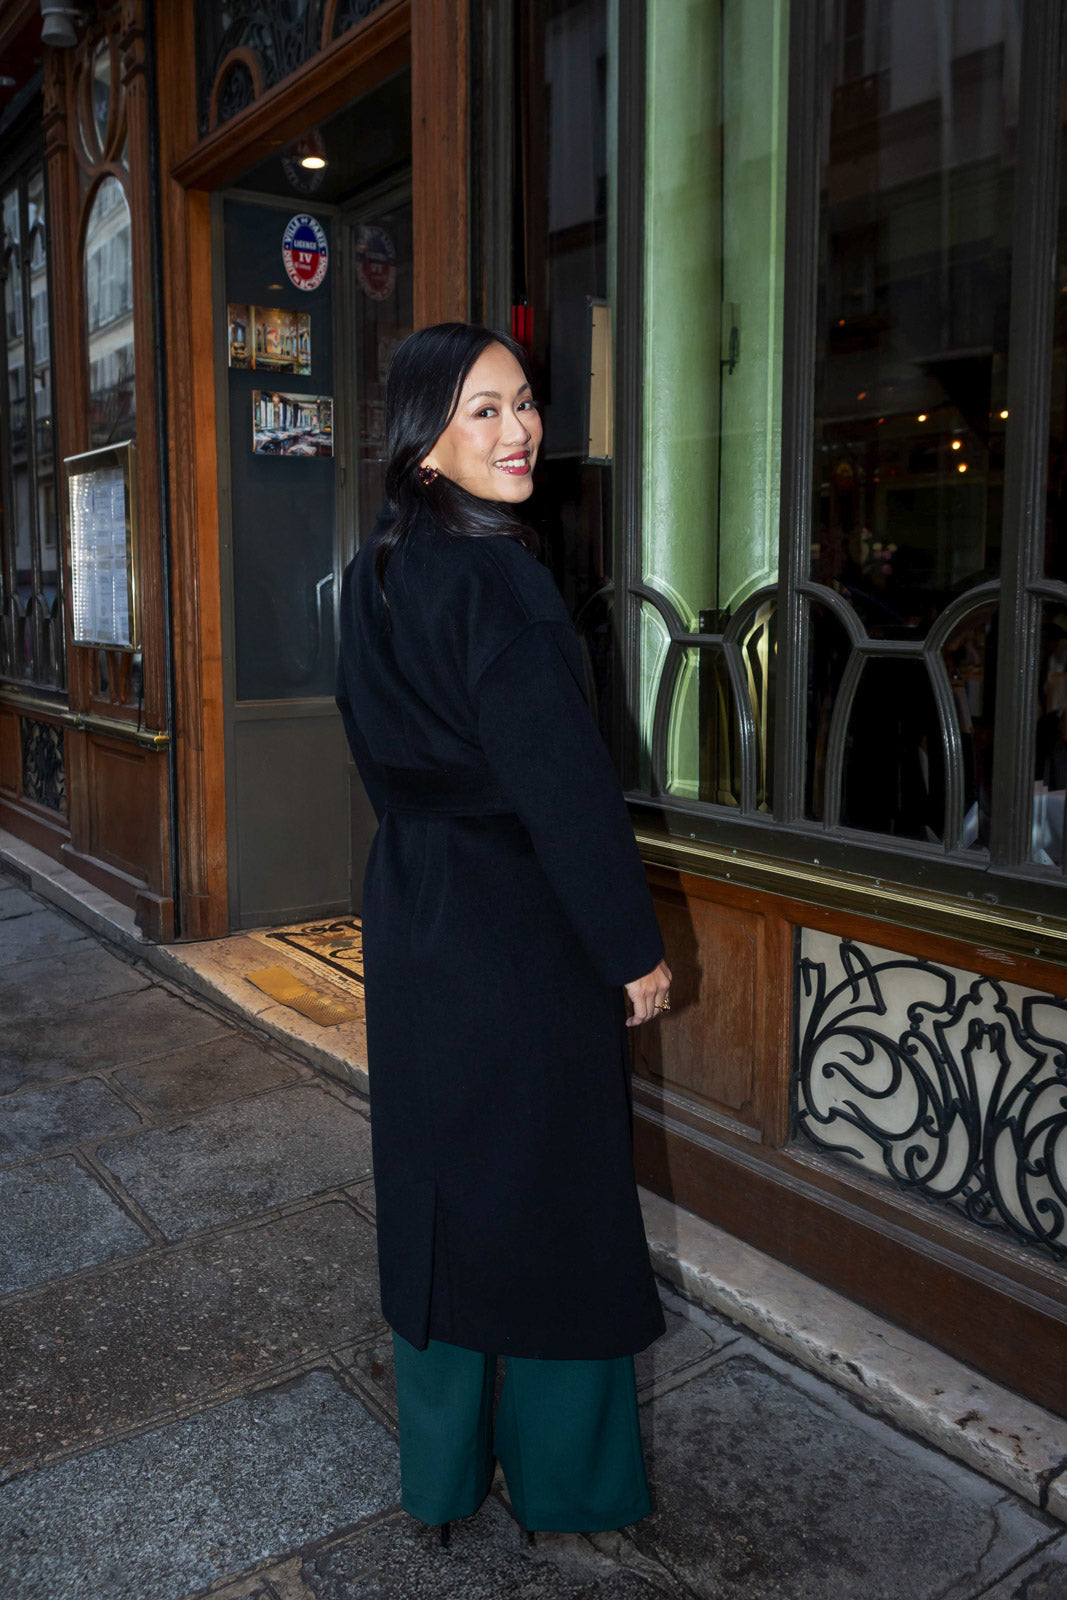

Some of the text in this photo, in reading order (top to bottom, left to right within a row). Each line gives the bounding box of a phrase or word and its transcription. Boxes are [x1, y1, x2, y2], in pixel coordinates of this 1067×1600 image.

[284, 219, 300, 242] VILLE
[309, 218, 327, 247] PARIS
[298, 252, 313, 264] IV
